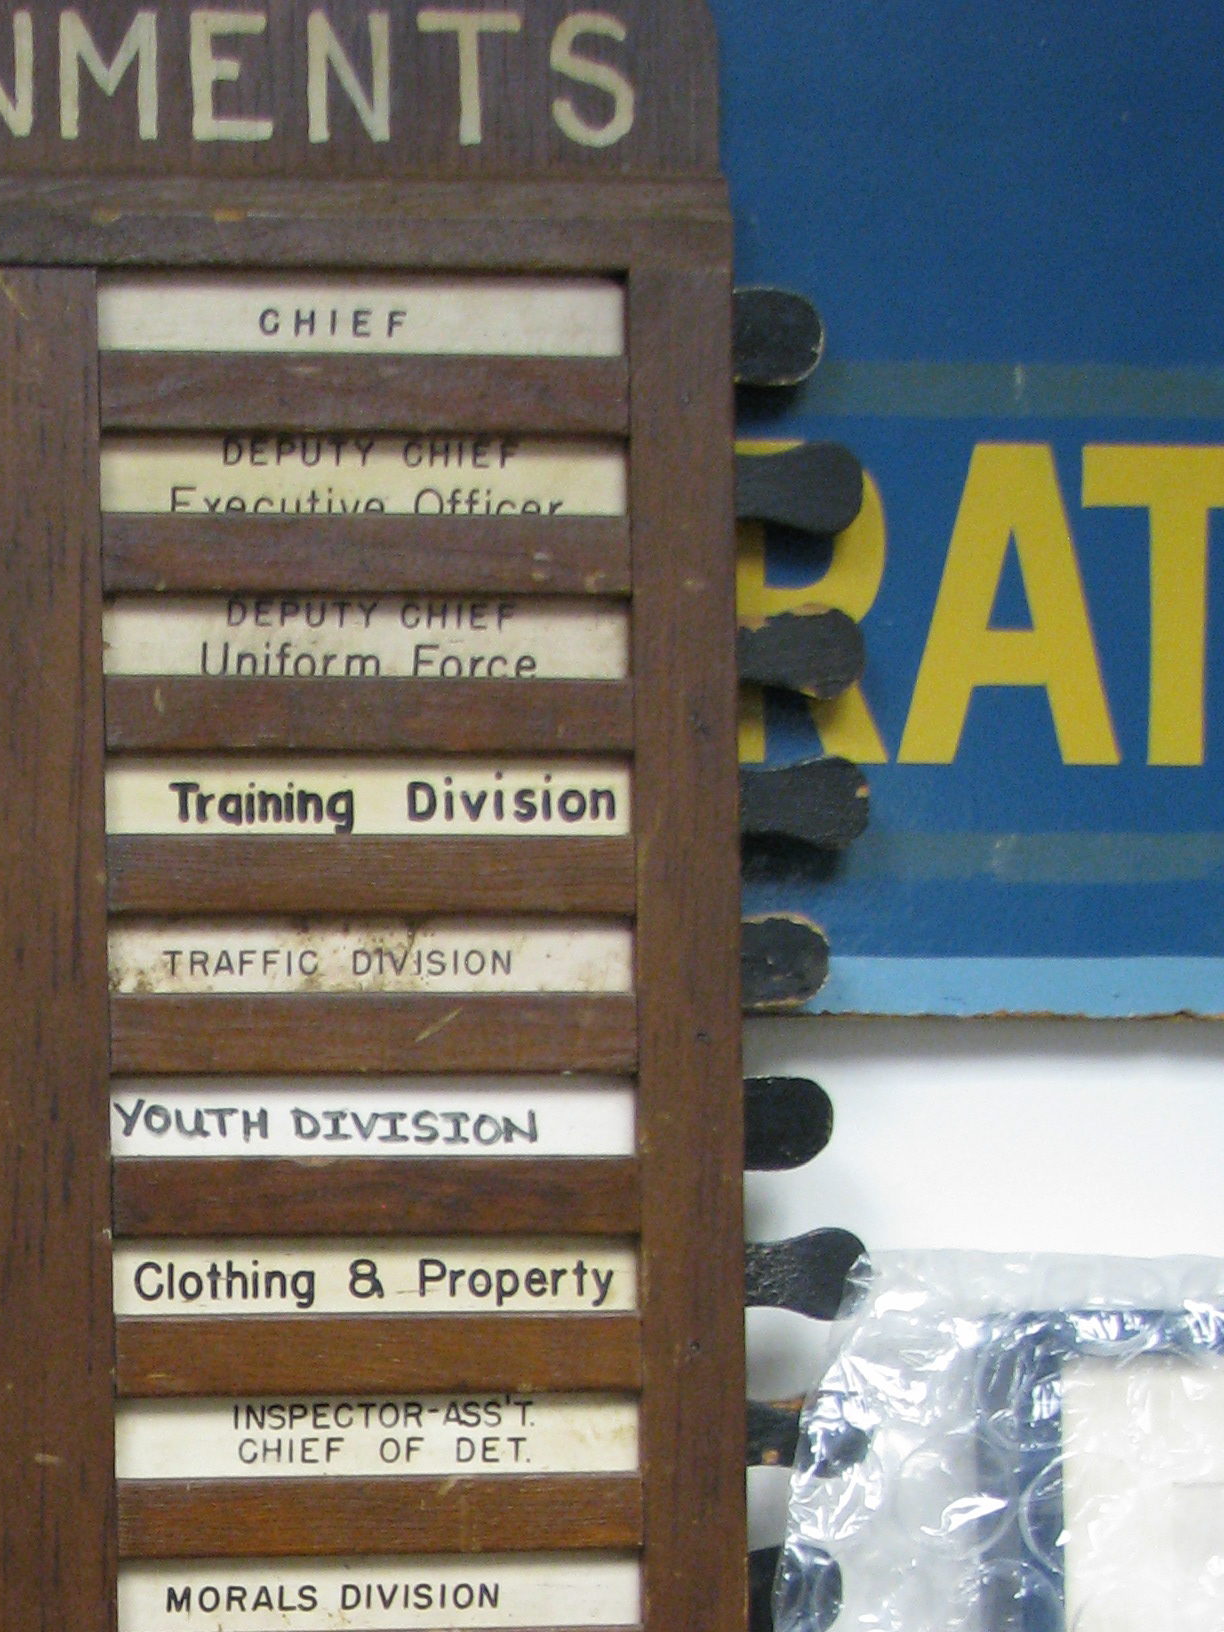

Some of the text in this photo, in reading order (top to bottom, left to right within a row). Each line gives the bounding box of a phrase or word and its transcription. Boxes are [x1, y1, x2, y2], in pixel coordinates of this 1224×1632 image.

[259, 308, 408, 339] CHIEF
[221, 437, 520, 469] DEPUTY CHIEF
[226, 600, 515, 630] DEPUTY CHIEF
[200, 642, 538, 679] Uniform Force
[169, 771, 617, 834] Training Division
[163, 948, 514, 977] TRAFFIC DIVISION
[290, 1107, 539, 1145] DIVISION
[133, 1259, 614, 1307] Clothing & Property
[238, 1437, 532, 1465] CHIEF OF DET.
[165, 1583, 500, 1613] MORALS DIVISION
